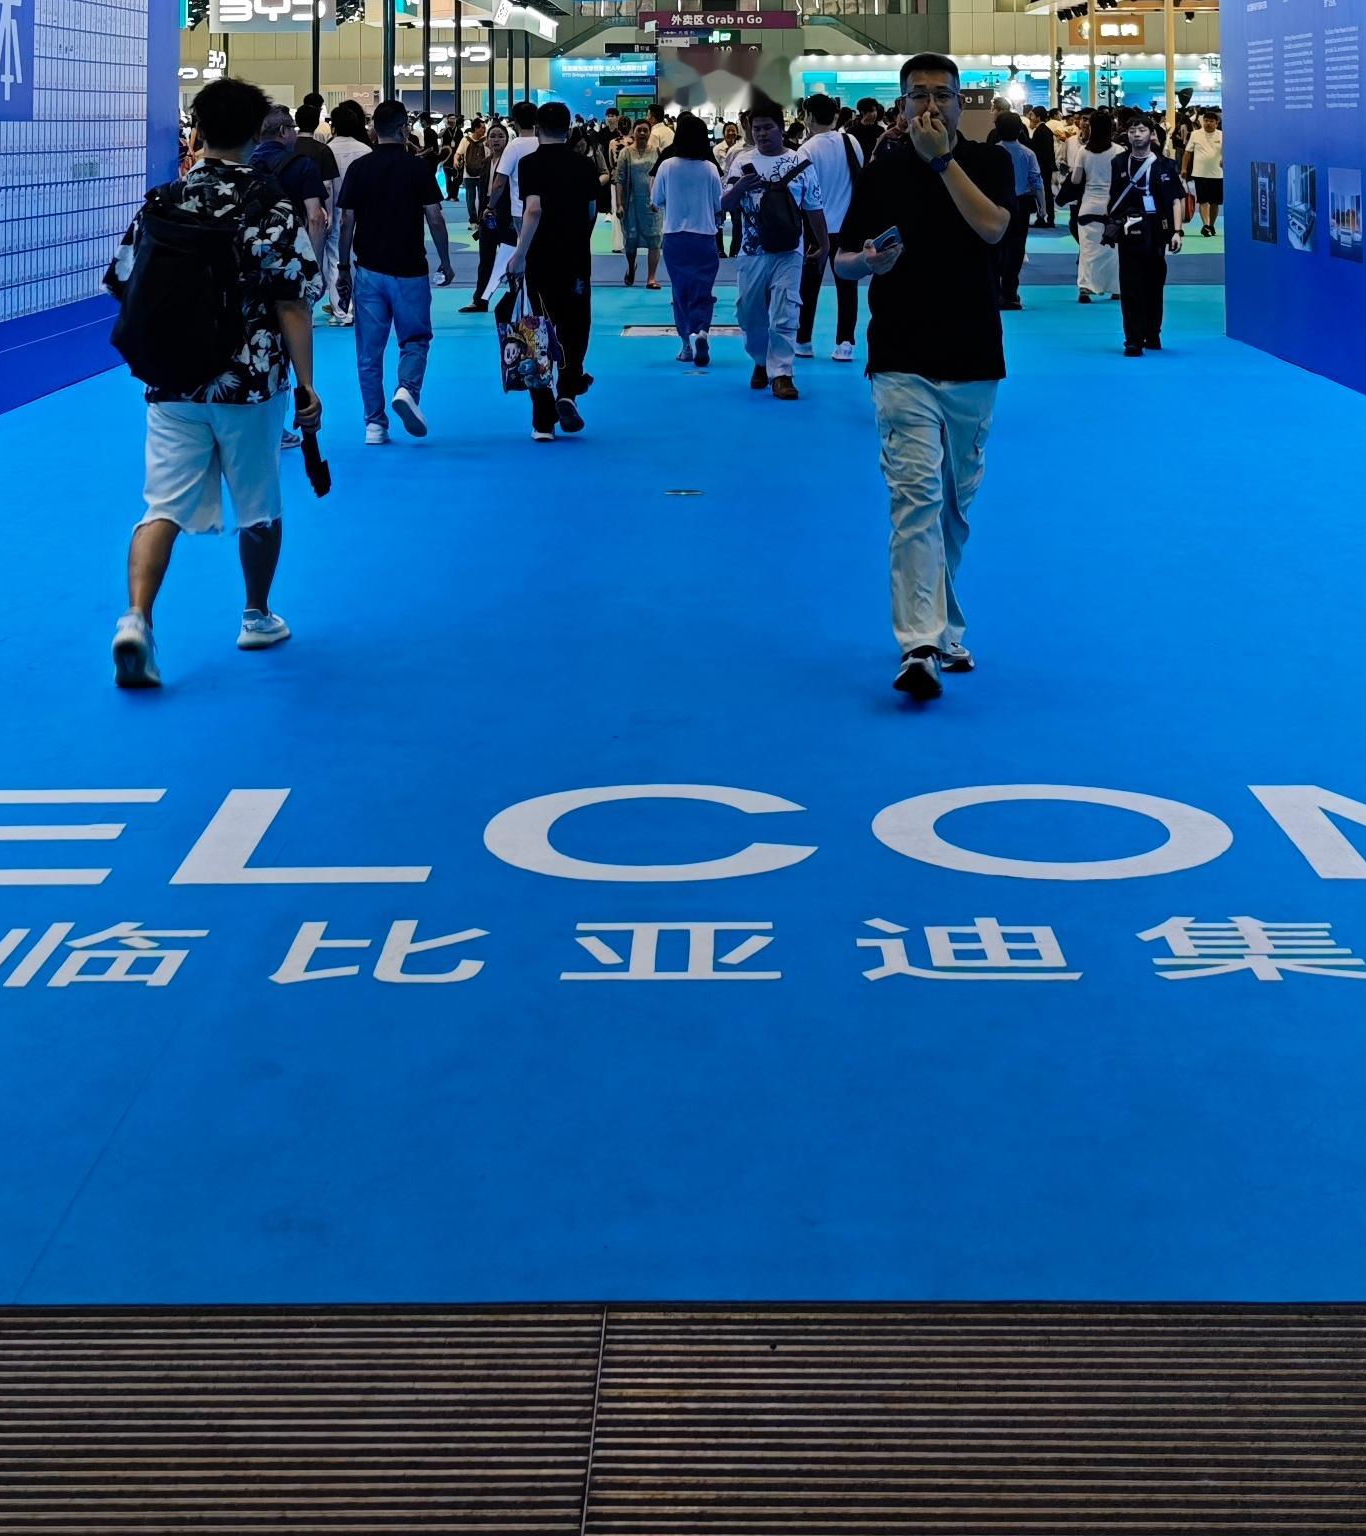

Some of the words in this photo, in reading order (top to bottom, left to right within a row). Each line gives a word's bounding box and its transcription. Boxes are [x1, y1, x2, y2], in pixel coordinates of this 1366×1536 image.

[671, 14, 704, 25] 外卖区
[707, 15, 734, 24] Grab
[747, 15, 763, 24] Go
[429, 47, 491, 62] BYD
